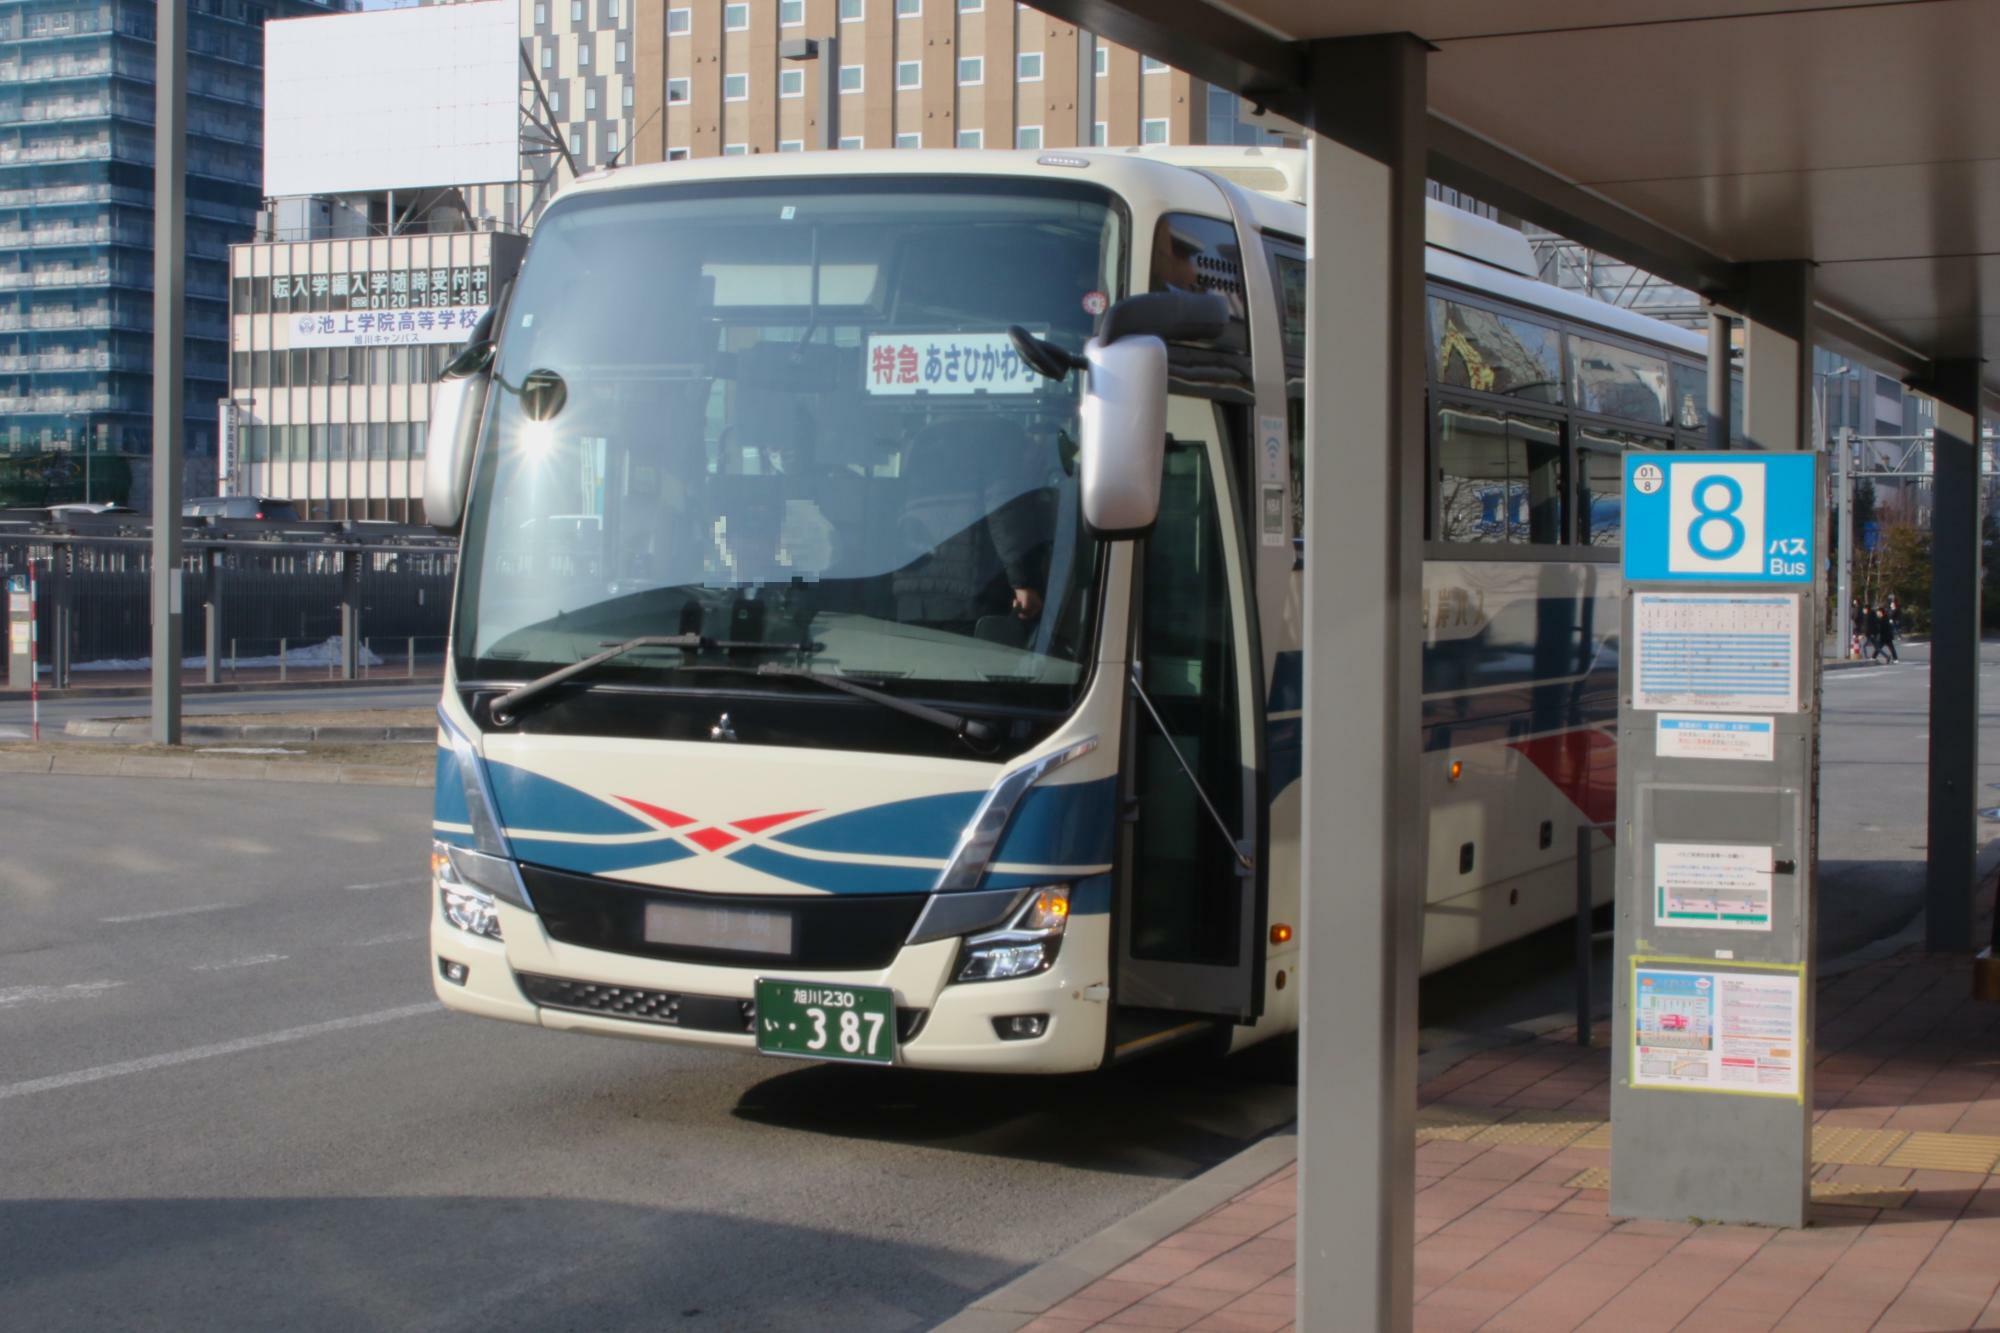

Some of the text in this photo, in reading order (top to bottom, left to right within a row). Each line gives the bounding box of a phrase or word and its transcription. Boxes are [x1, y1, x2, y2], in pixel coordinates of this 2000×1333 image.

[272, 268, 488, 298] 転入学編入学随時受付中
[371, 290, 487, 308] 0120-195-315
[317, 309, 479, 335] 池上学院高等学校
[872, 345, 919, 384] 特急
[1640, 467, 1654, 478] 01
[1644, 481, 1651, 492] 8
[1687, 474, 1746, 561] 8
[1769, 538, 1808, 555] バス
[1769, 558, 1806, 575] Bus
